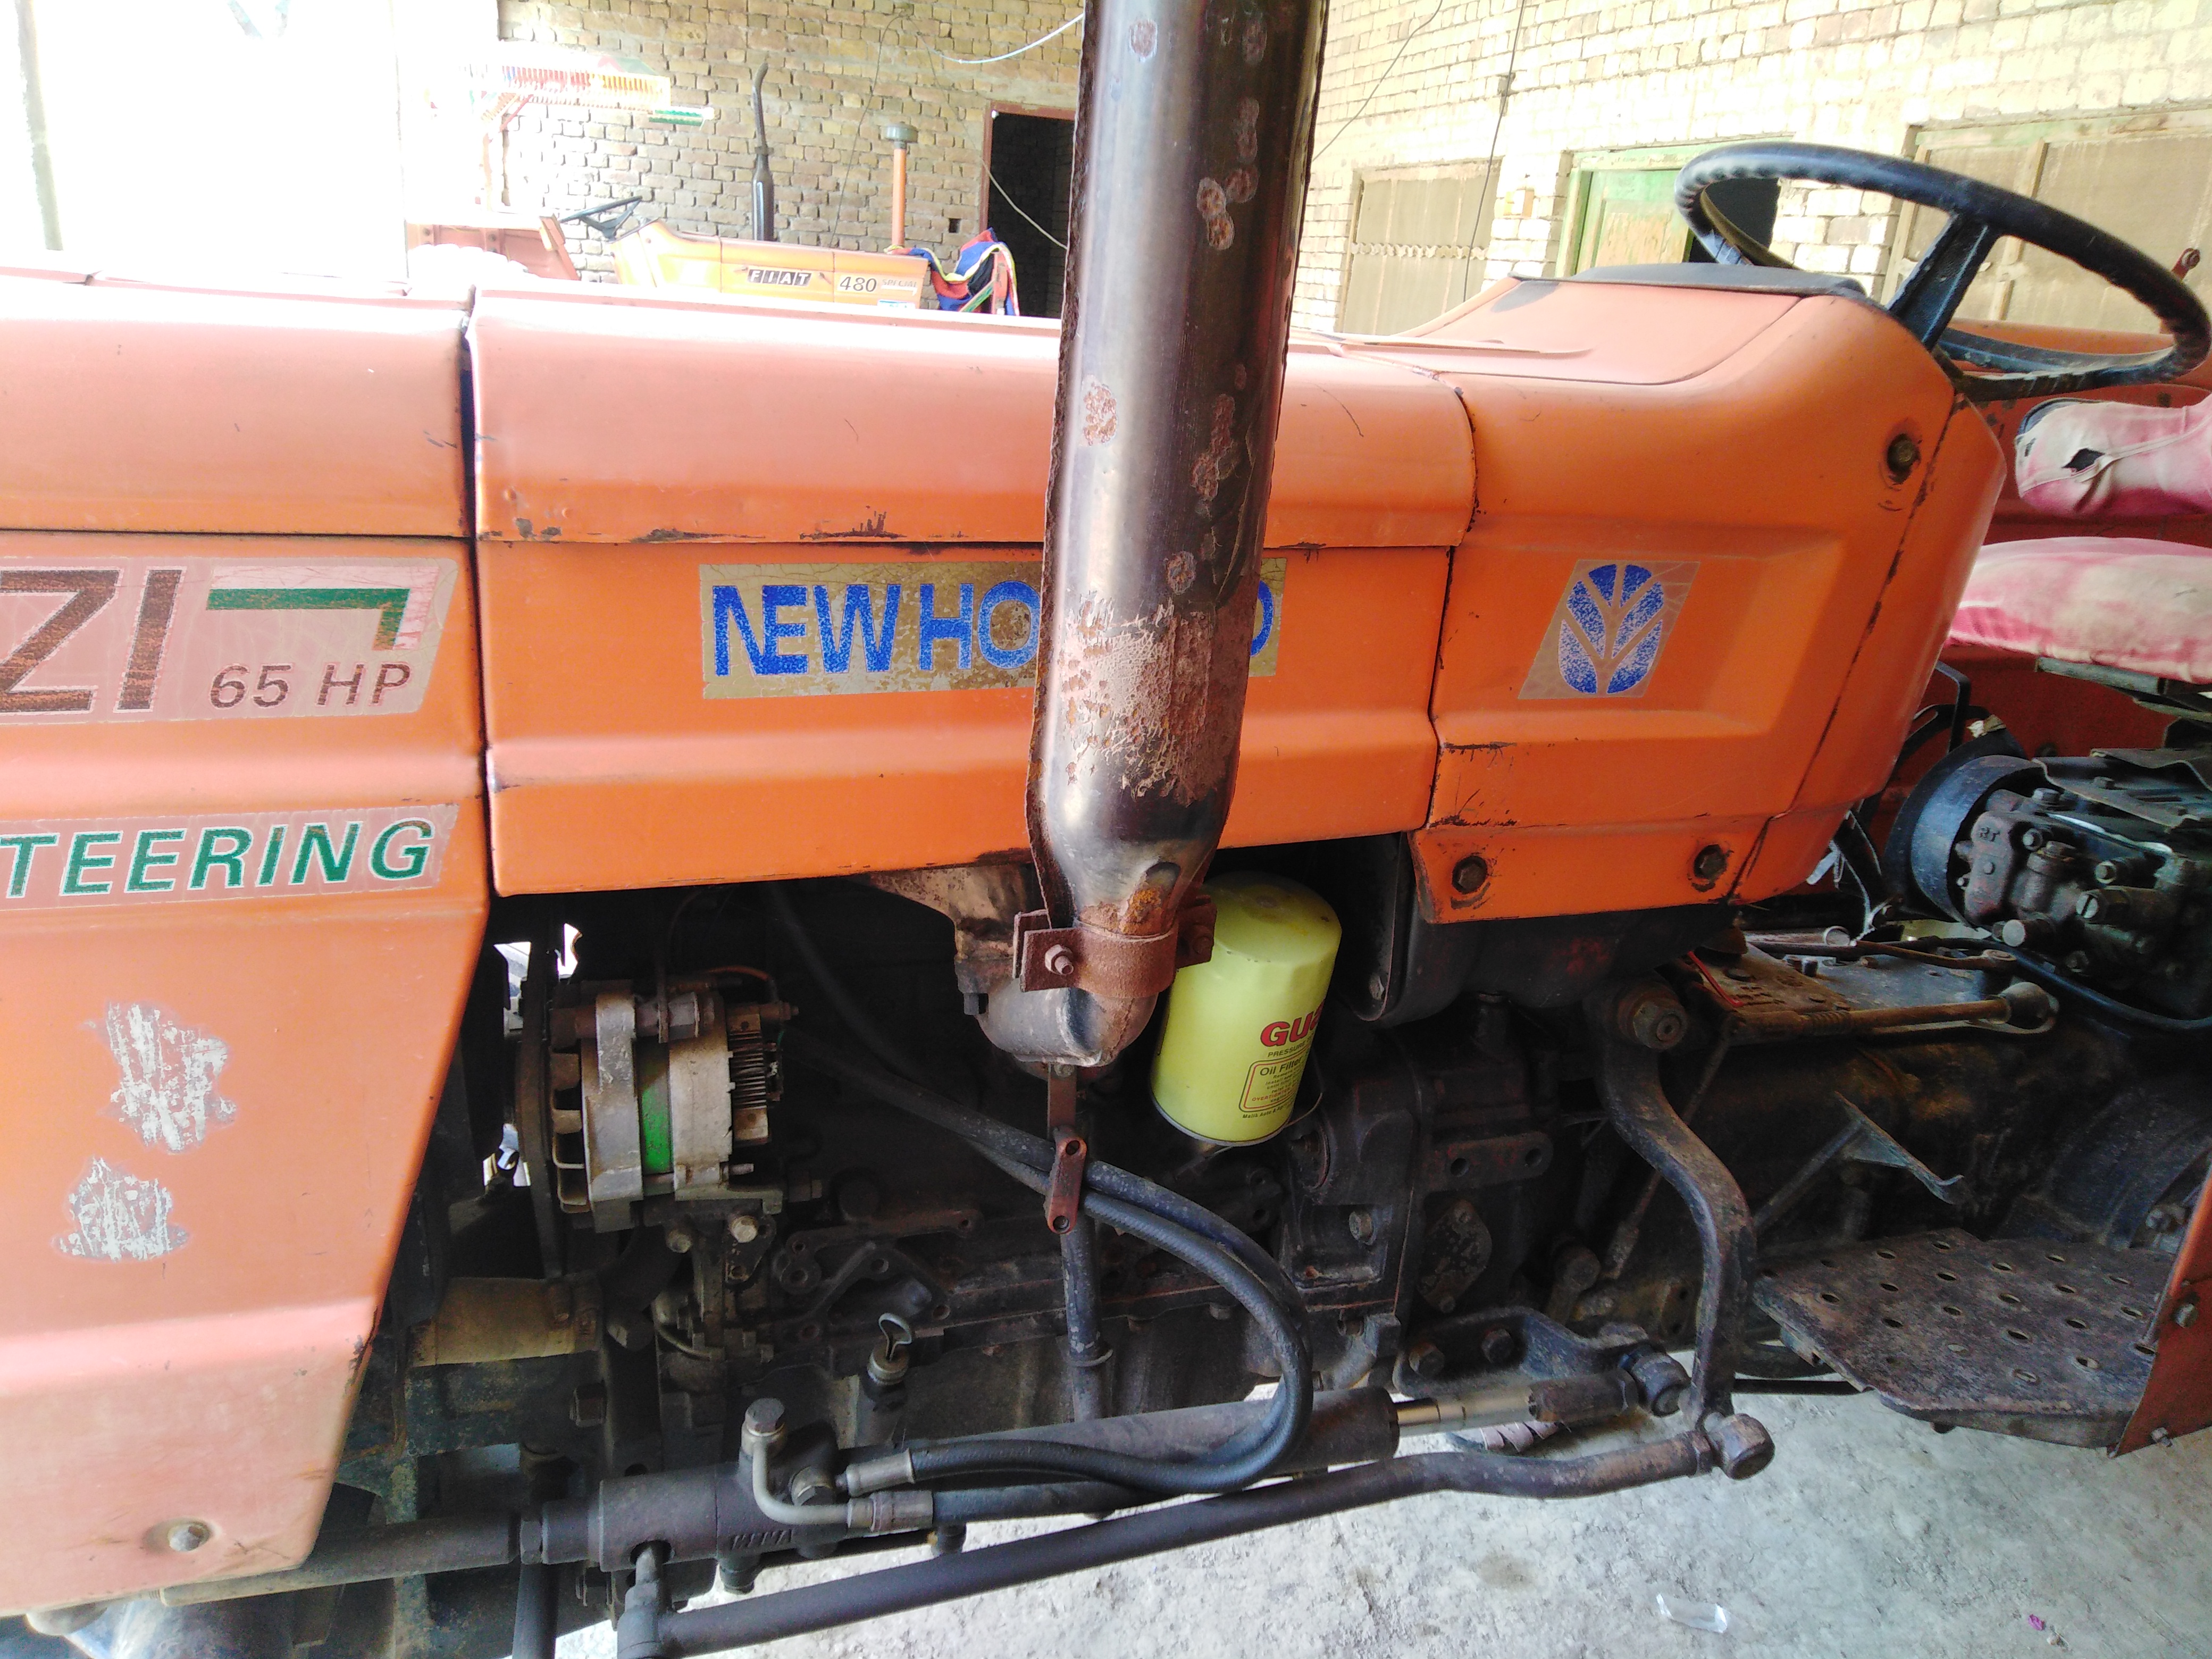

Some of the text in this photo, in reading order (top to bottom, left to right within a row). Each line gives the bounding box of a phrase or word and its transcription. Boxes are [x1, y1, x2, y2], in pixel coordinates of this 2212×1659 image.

[750, 270, 810, 286] FIAT
[840, 276, 877, 292] 480
[713, 584, 902, 677] NEW
[210, 662, 412, 709] 65 HP
[1268, 1041, 1306, 1057] PRESSURE
[1260, 1066, 1276, 1076] Oil
[1279, 1056, 1302, 1072] Filter
